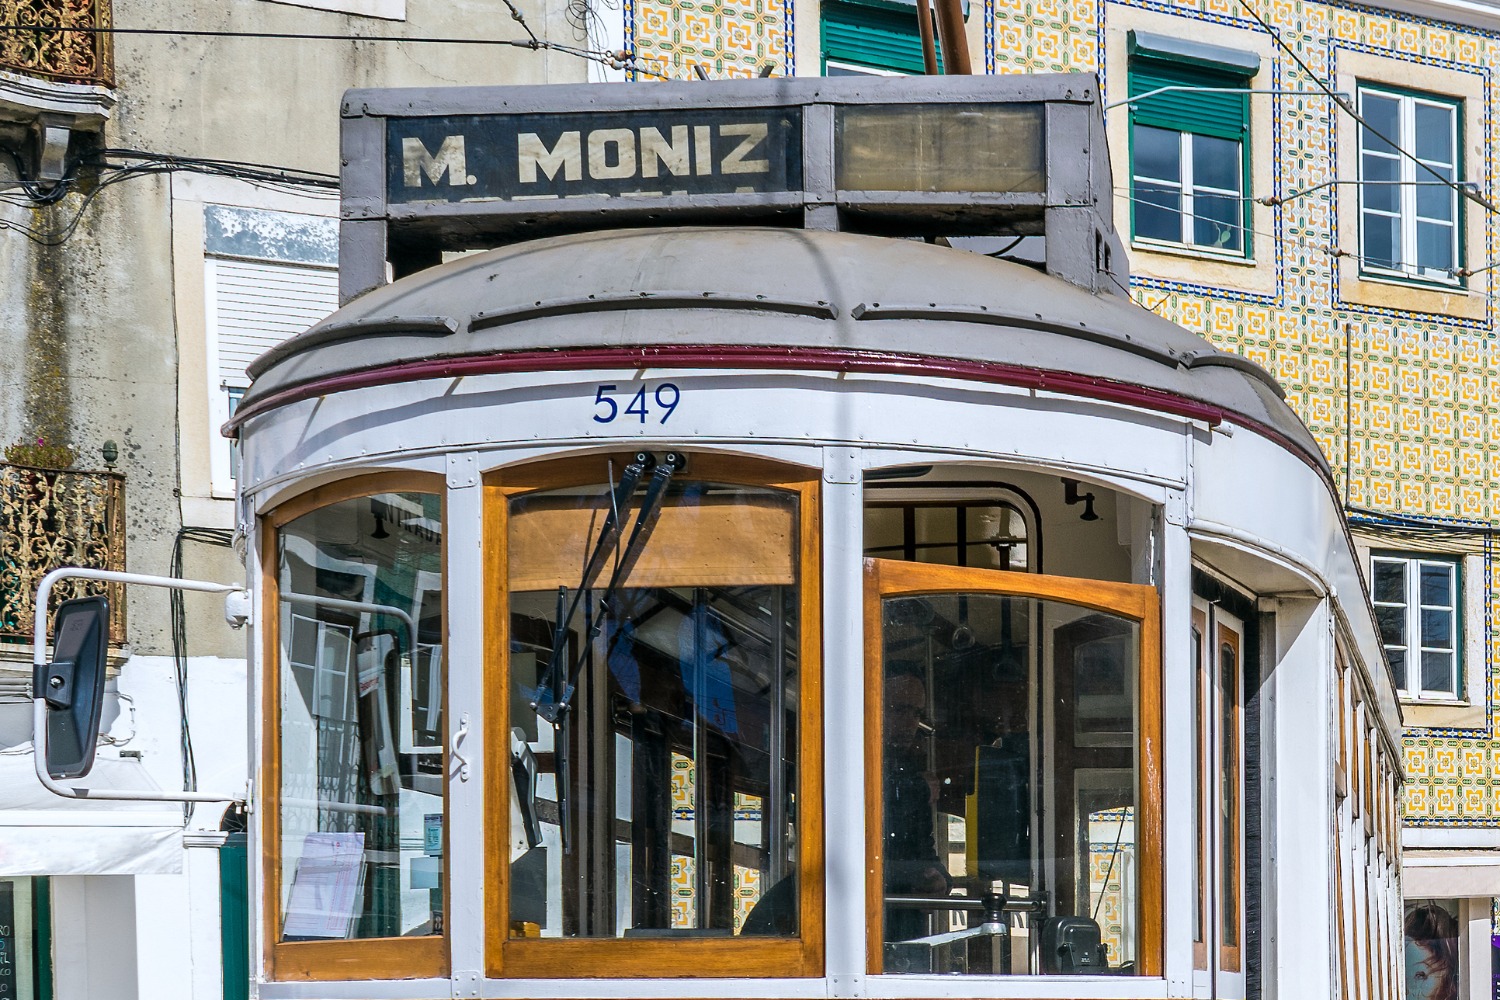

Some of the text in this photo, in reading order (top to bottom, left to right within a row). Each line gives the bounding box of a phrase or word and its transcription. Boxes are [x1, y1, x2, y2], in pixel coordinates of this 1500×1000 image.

[402, 122, 770, 188] M. MONIZ
[593, 383, 680, 425] 549
